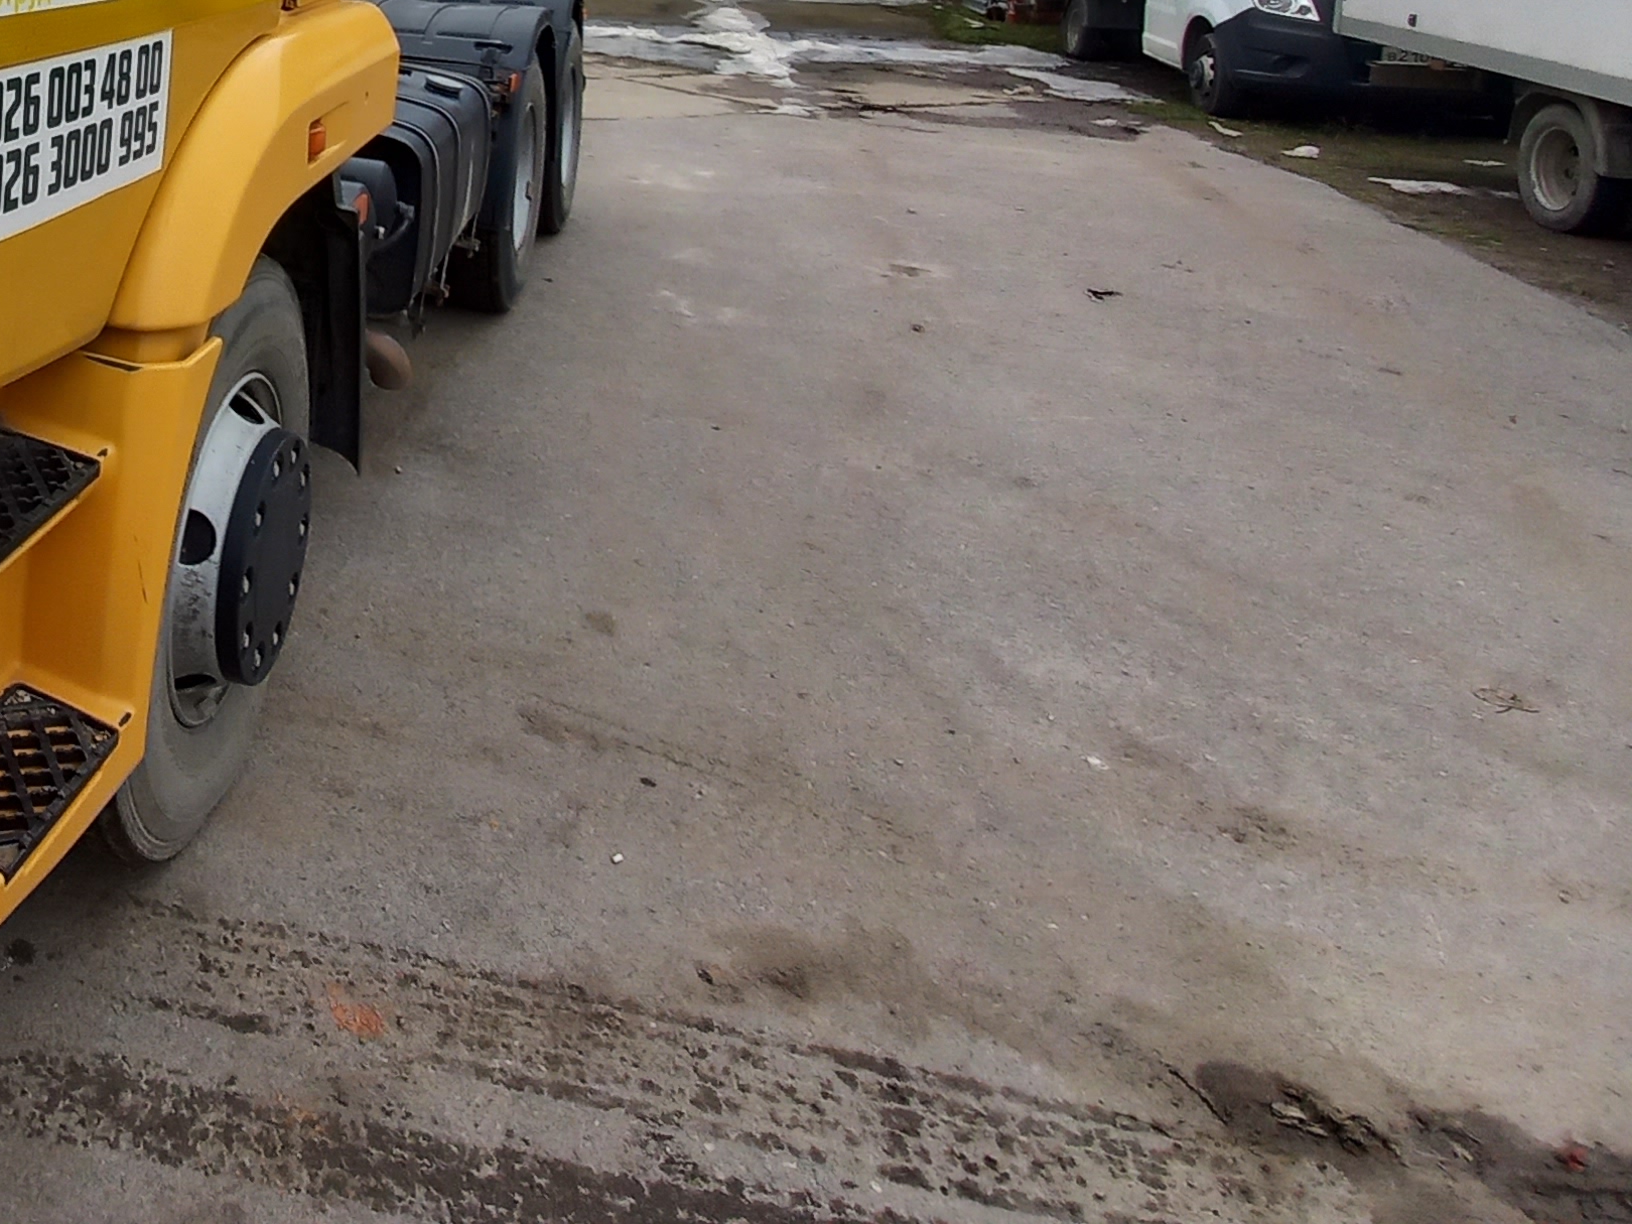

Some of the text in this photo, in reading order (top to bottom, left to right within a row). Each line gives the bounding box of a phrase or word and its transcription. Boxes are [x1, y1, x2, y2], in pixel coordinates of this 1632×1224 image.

[47, 58, 96, 130] 003
[100, 48, 132, 111] 48
[135, 40, 164, 99] 00
[47, 117, 113, 197] 3000
[118, 101, 159, 167] 995
